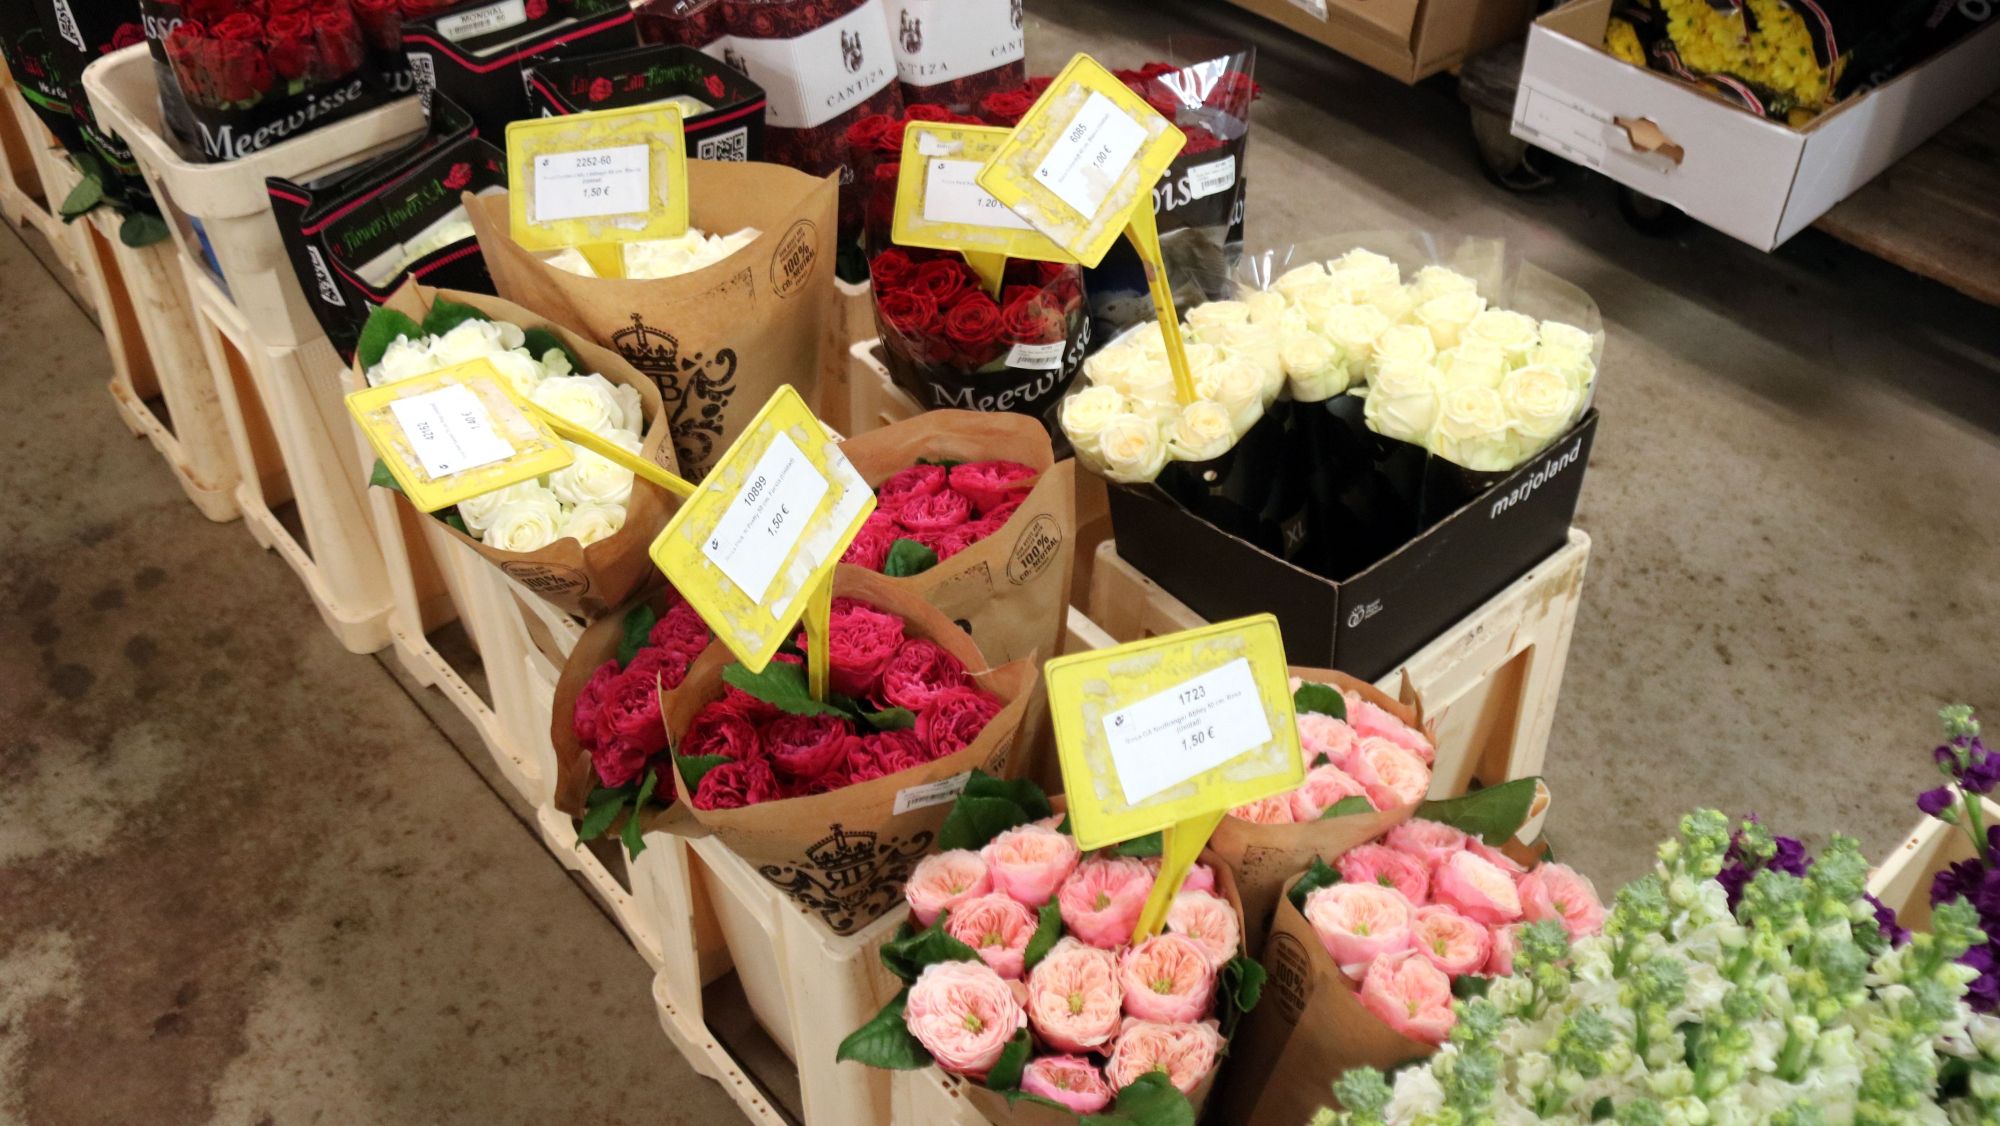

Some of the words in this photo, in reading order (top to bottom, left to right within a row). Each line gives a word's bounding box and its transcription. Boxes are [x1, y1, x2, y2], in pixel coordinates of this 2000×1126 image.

[826, 67, 884, 108] CANTIZA
[197, 78, 363, 161] Meewisse
[1069, 122, 1089, 143] 6085
[576, 155, 612, 168] 2252-60
[583, 187, 602, 199] 1,50
[783, 241, 810, 277] 100%
[929, 316, 1092, 413] Meewisse
[744, 475, 767, 506] 10899
[1490, 437, 1582, 519] marjoland
[767, 512, 784, 537] 1,50
[1020, 533, 1049, 568] 100%
[1178, 684, 1207, 705] 1723
[1181, 731, 1205, 751] 1,50
[1208, 726, 1216, 739] €
